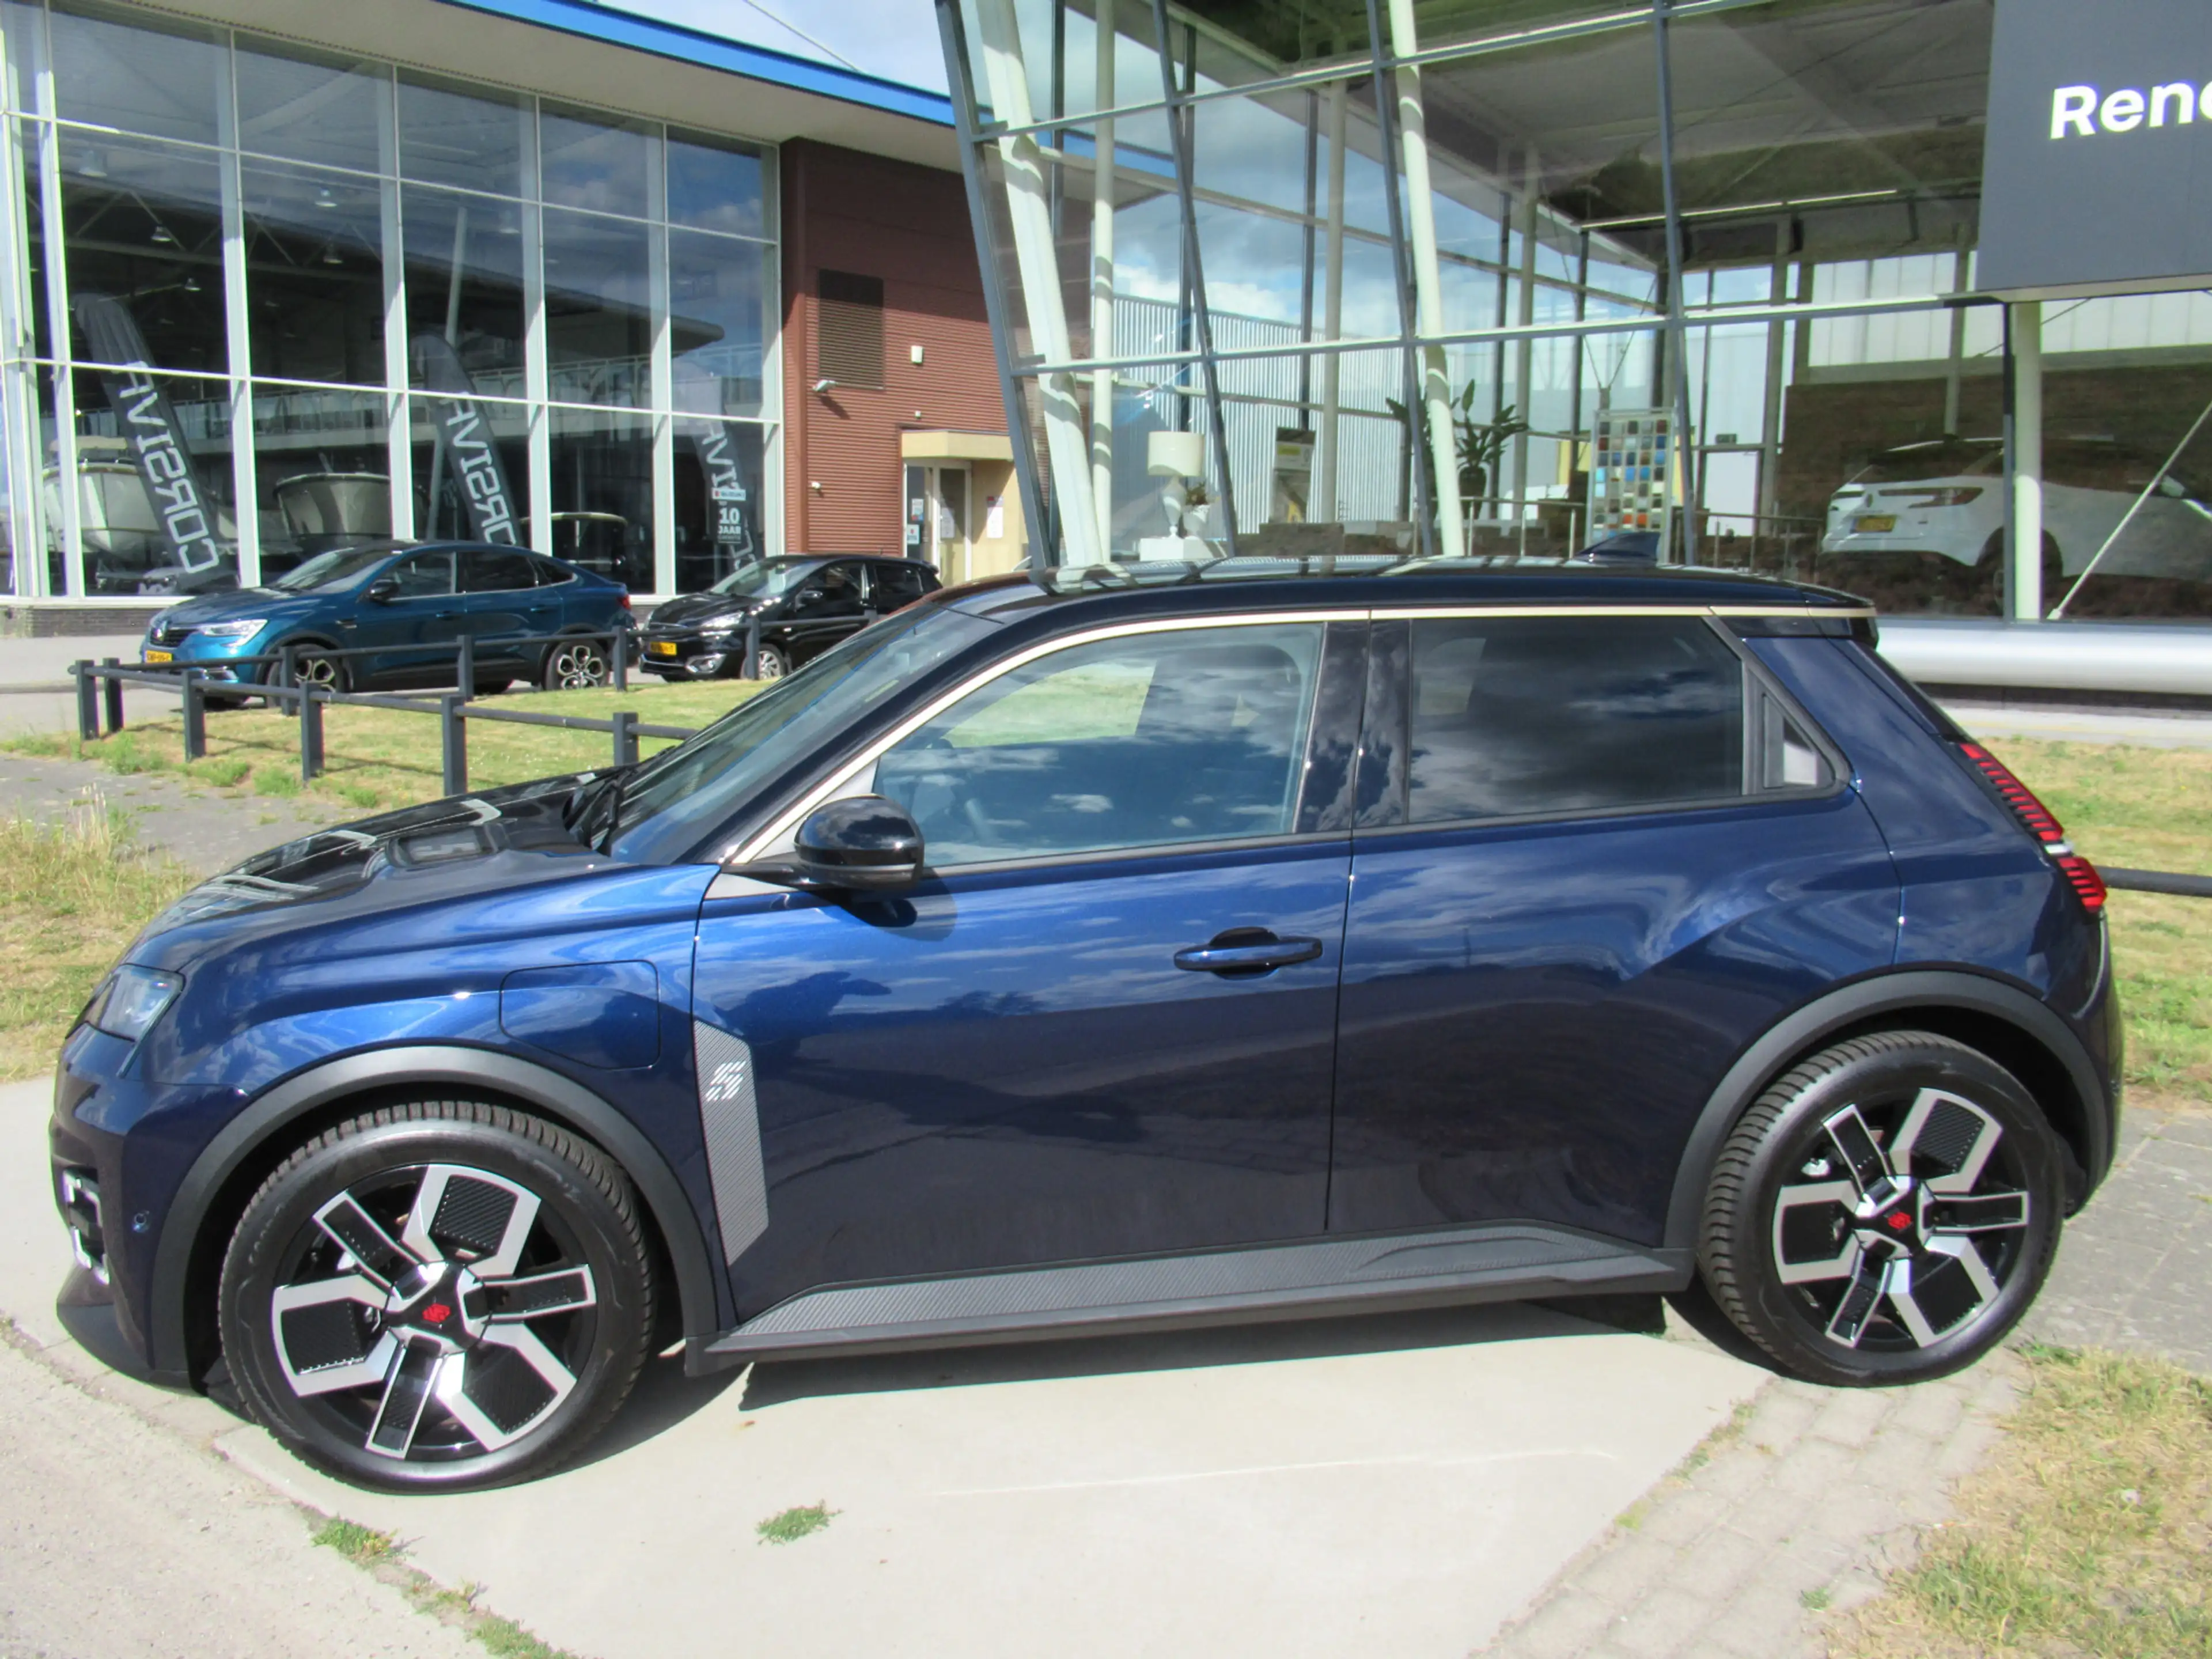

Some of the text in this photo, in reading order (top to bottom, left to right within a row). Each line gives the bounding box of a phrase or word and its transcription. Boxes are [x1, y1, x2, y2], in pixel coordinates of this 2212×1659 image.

[2050, 79, 2212, 139] Ren
[719, 507, 740, 524] 10
[718, 525, 741, 535] JAAR
